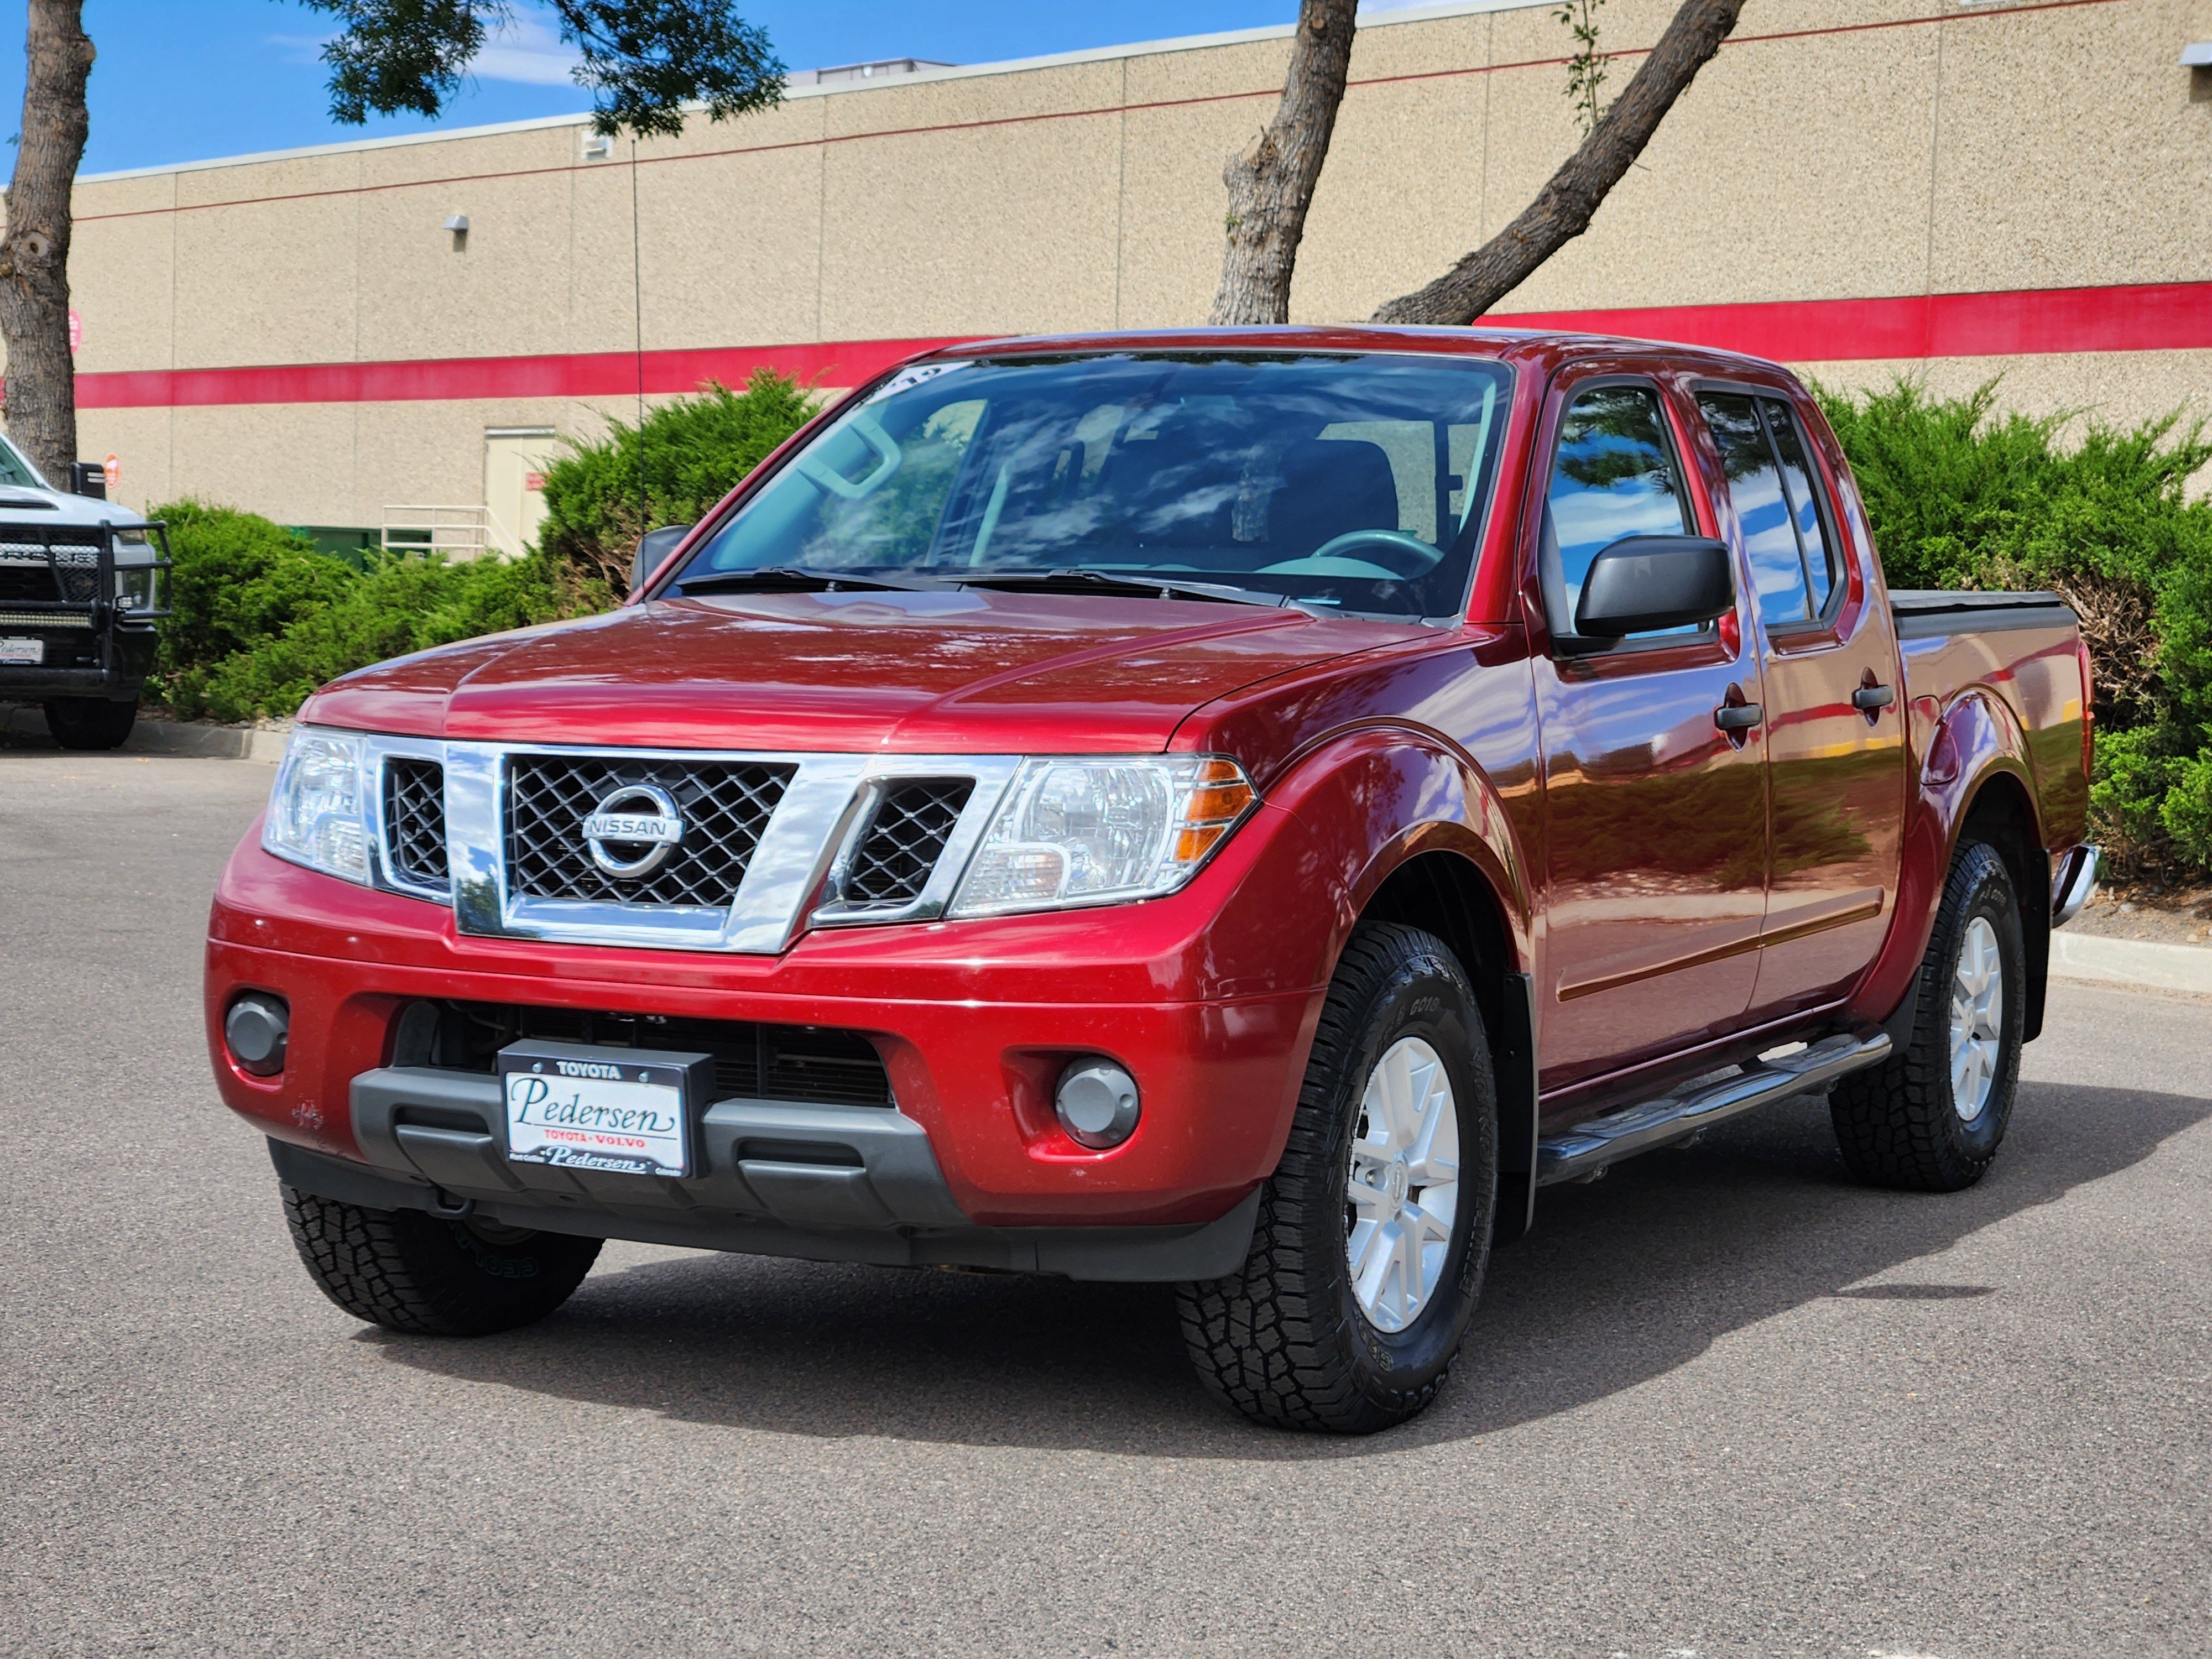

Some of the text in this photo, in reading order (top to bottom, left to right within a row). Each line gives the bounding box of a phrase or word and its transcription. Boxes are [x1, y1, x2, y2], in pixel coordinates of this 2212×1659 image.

[589, 819, 666, 836] NISSAN
[556, 1061, 622, 1080] TOYOTA
[511, 1077, 675, 1132] Pedersen
[544, 1129, 645, 1148] TOYOTA VOLVO
[546, 1145, 647, 1171] Pedersen
